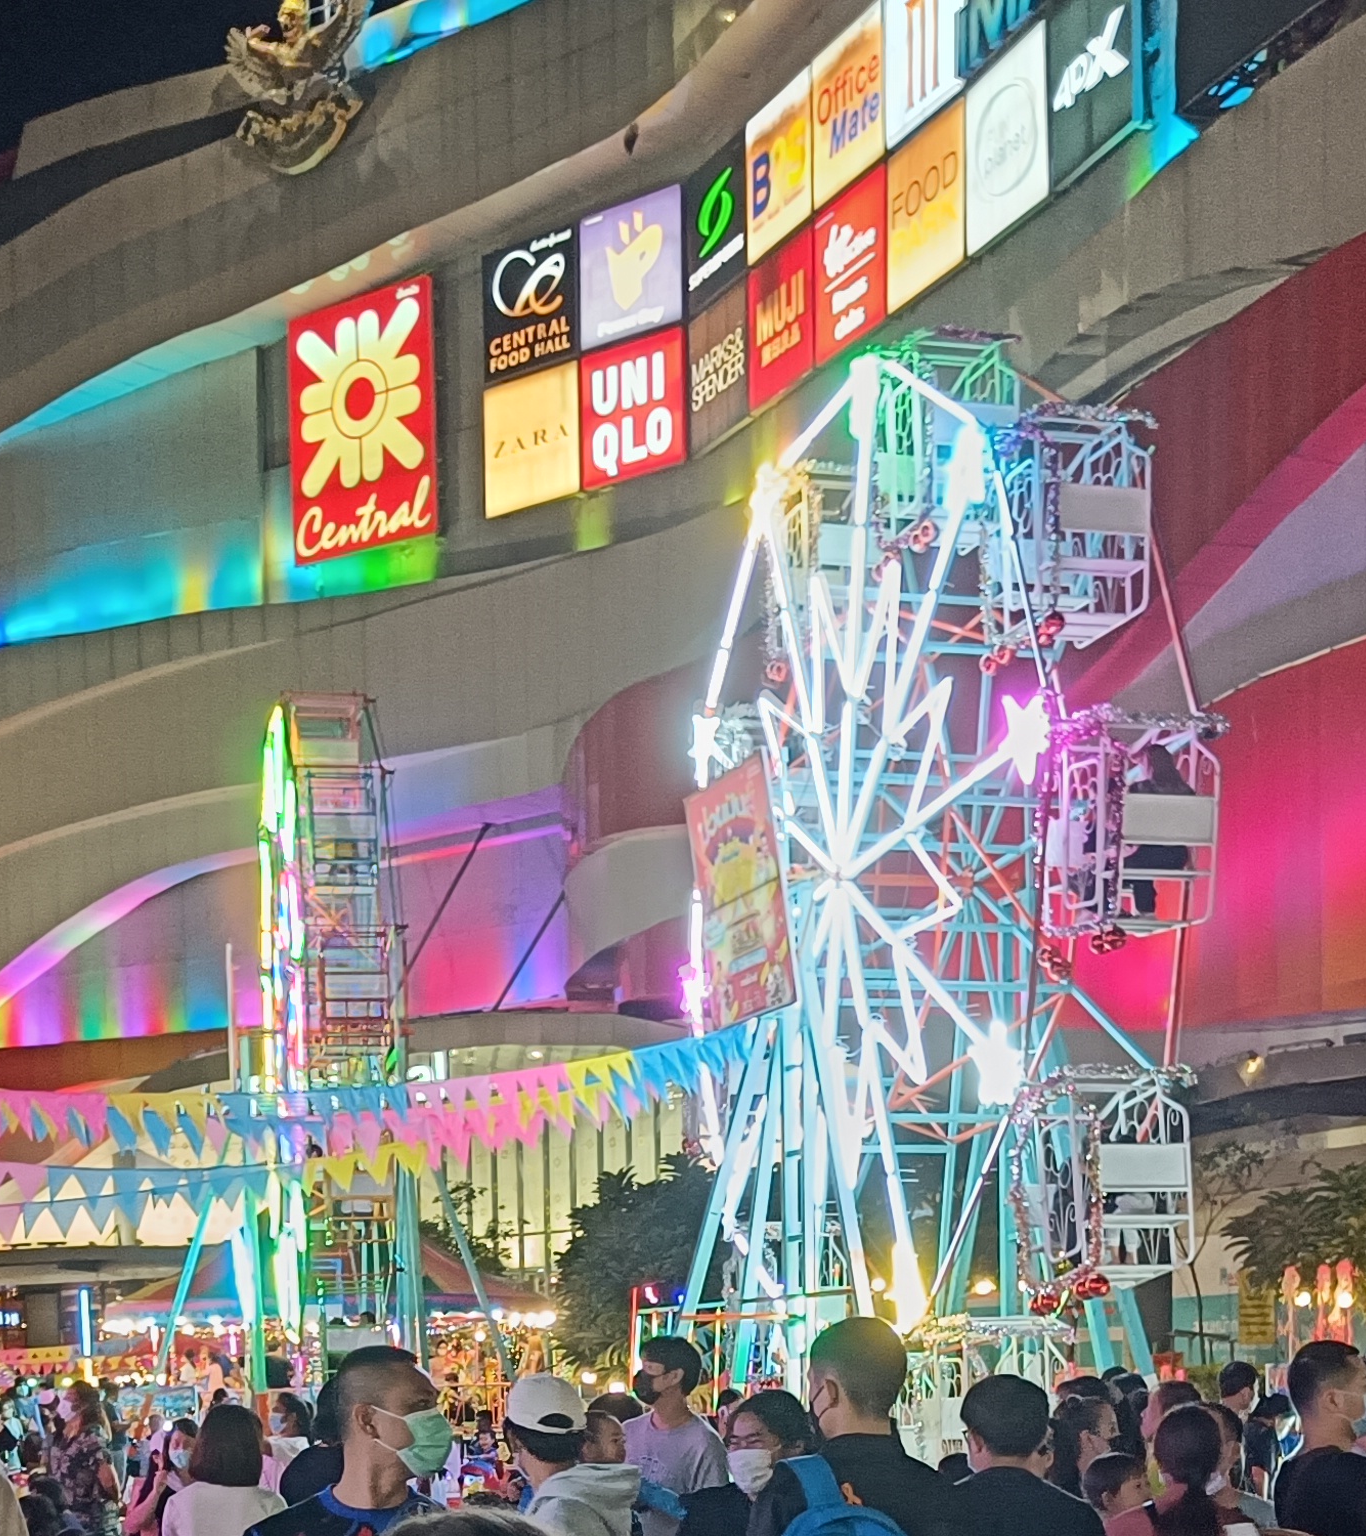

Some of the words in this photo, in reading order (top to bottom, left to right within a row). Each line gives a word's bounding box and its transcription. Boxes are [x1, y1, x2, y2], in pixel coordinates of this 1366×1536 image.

[817, 54, 879, 126] Office
[829, 92, 879, 158] Mate
[892, 151, 958, 230] FOOD
[489, 316, 570, 357] CENTRAL
[756, 269, 805, 346] MUJI
[489, 347, 531, 374] FOOD
[534, 334, 571, 358] HALL
[592, 351, 665, 417] UNI
[692, 353, 745, 412] SPENCER
[494, 424, 569, 459] ZARA
[592, 407, 673, 476] QLO
[296, 475, 431, 557] Central
